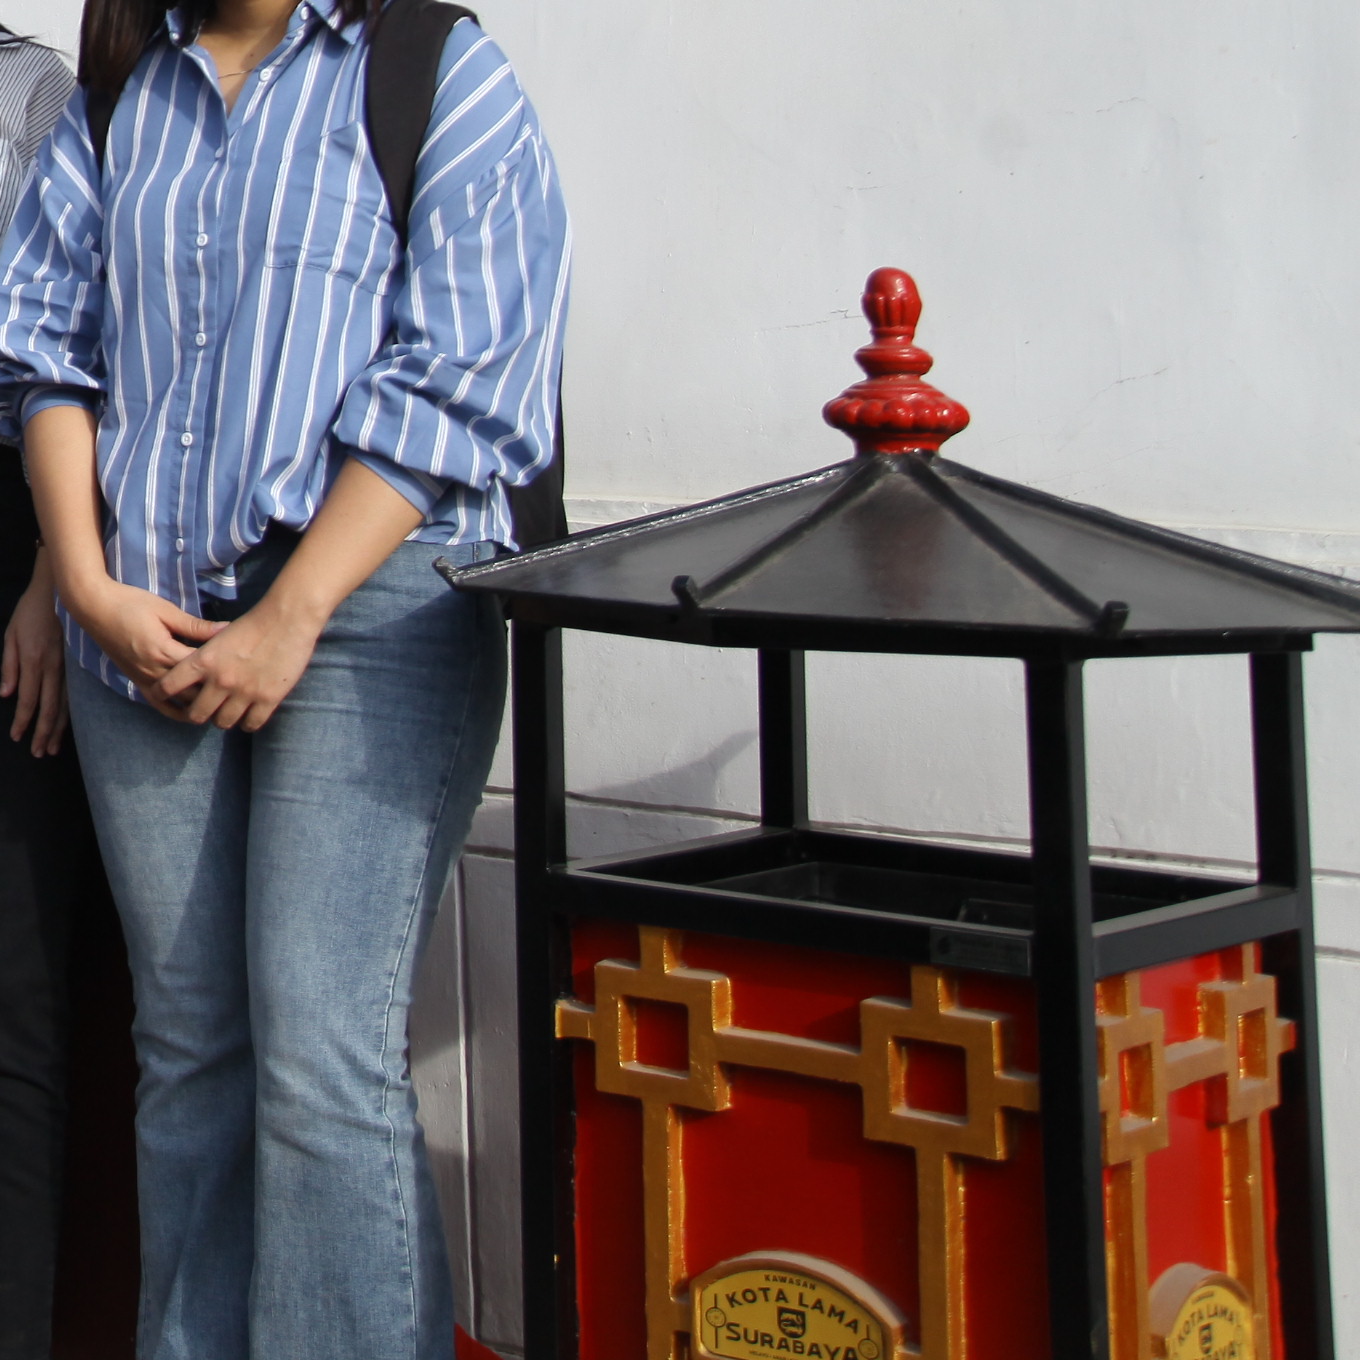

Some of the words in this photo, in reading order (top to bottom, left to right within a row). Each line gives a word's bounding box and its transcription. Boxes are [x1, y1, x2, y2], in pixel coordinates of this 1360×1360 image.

[764, 1274, 817, 1290] KAWASAN
[726, 1287, 789, 1308] KOTA
[798, 1292, 859, 1334] LAMA
[725, 1322, 859, 1360] SURABAYA
